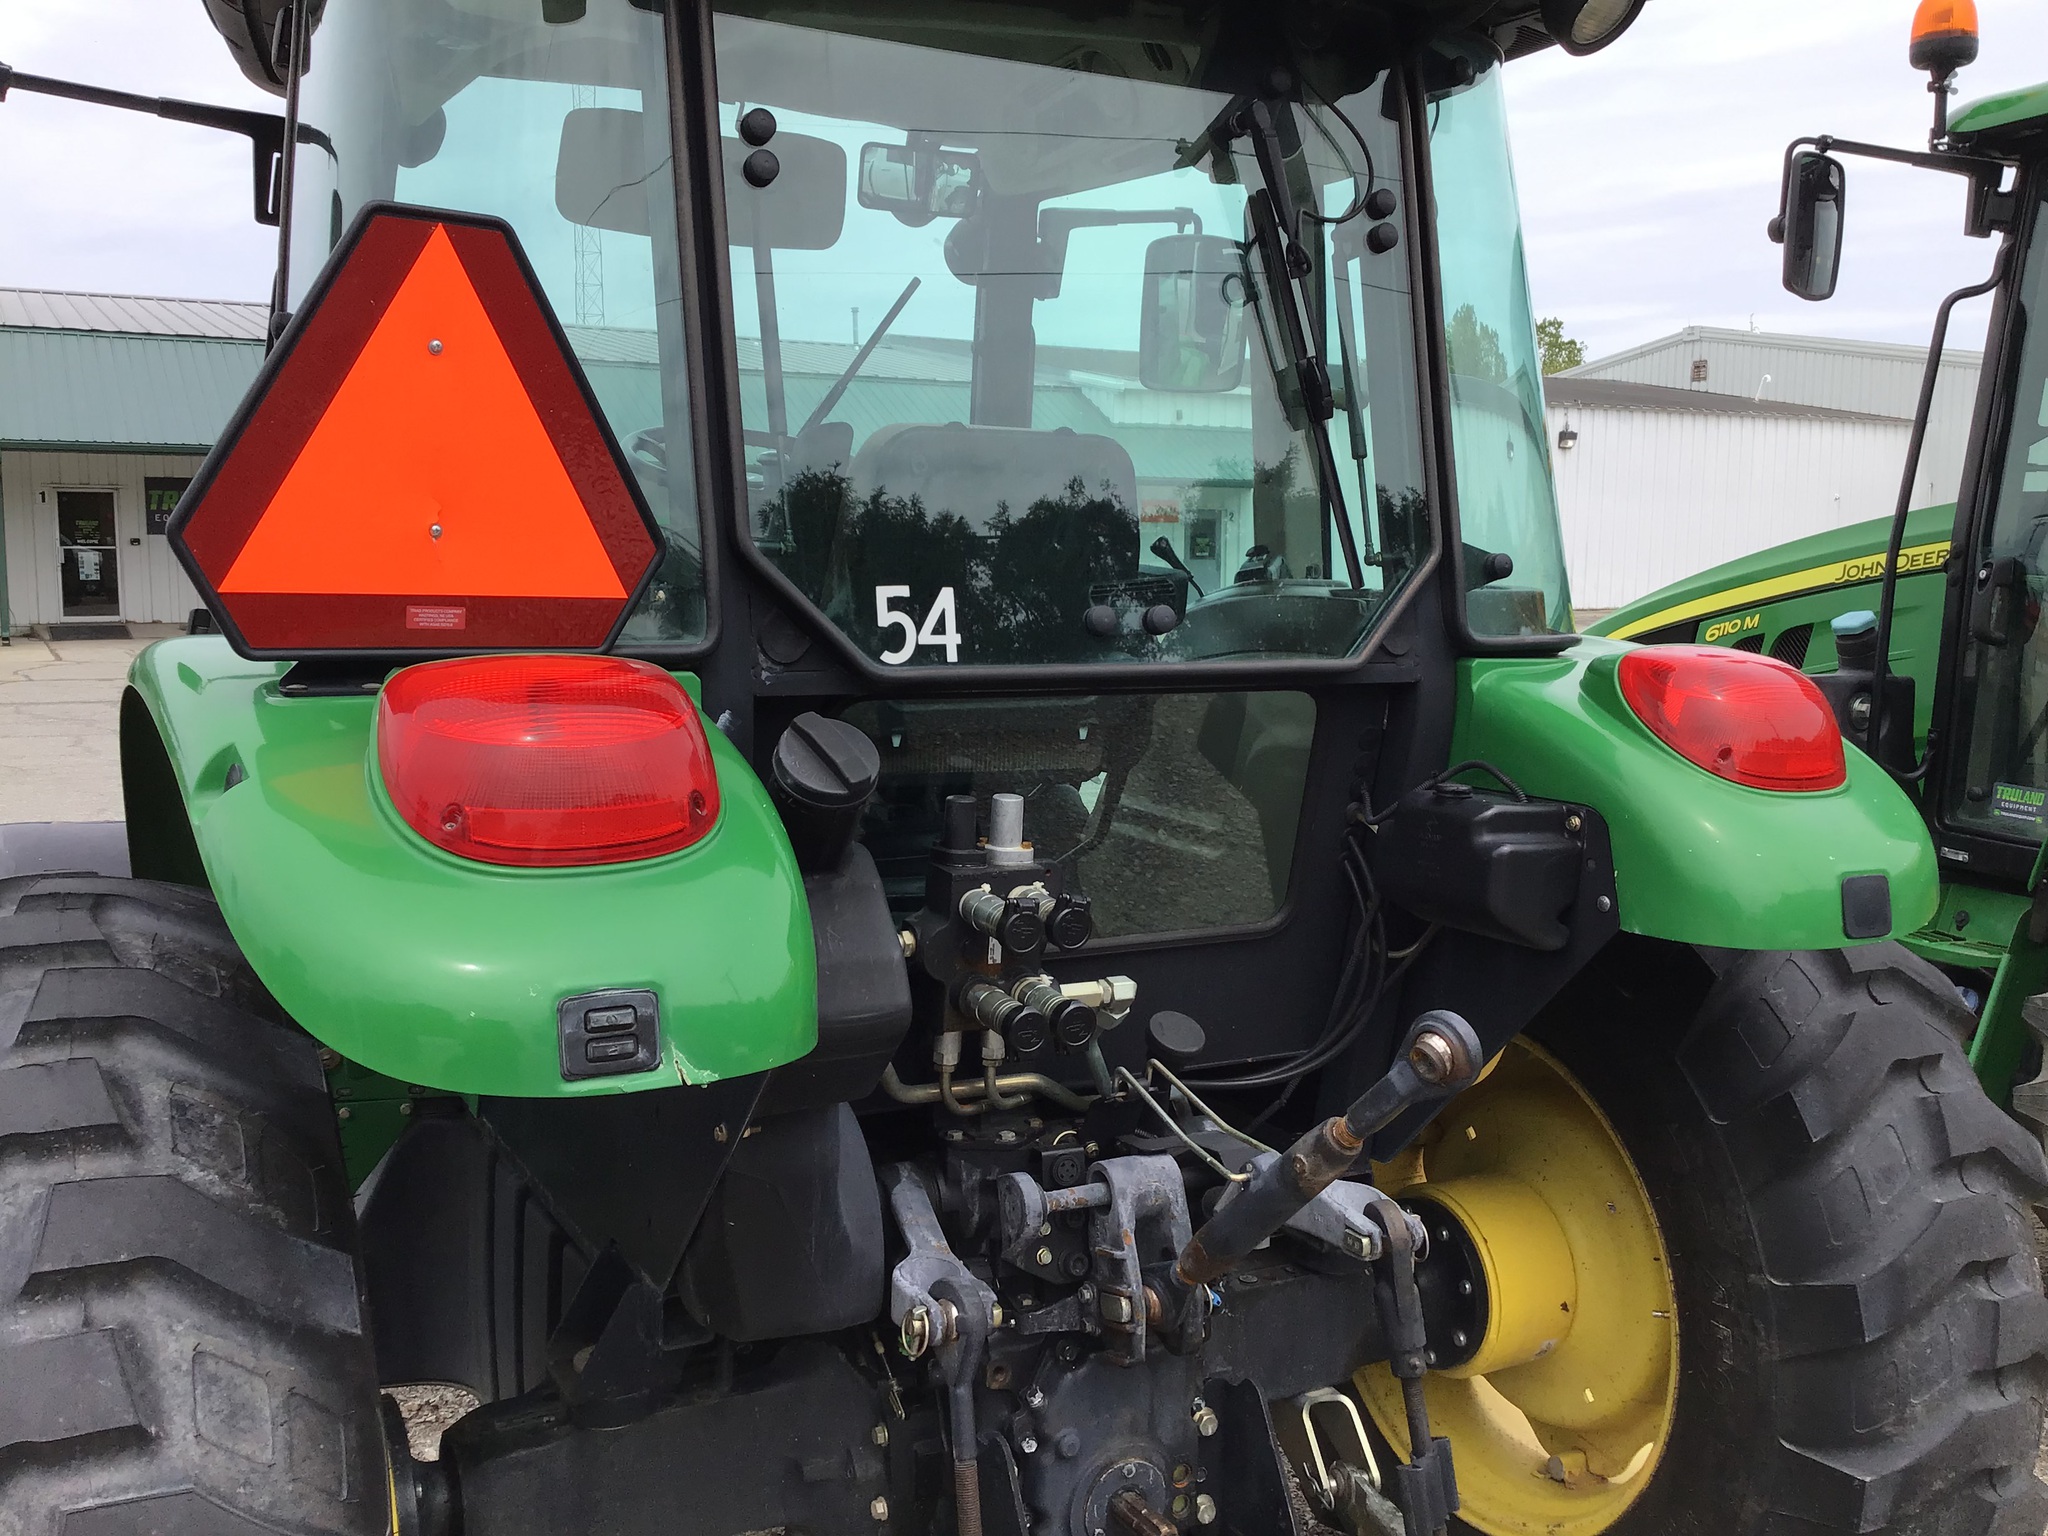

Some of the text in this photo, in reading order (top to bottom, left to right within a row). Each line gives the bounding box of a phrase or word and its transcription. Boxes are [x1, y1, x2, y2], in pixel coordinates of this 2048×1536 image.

[39, 491, 46, 503] 1
[148, 490, 182, 510] TR
[1896, 549, 1951, 570] DEER
[875, 585, 962, 665] 54
[1705, 613, 1760, 642] 6110 M
[1996, 785, 2045, 806] TRULAND
[2001, 801, 2037, 812] EQUIPMENT
